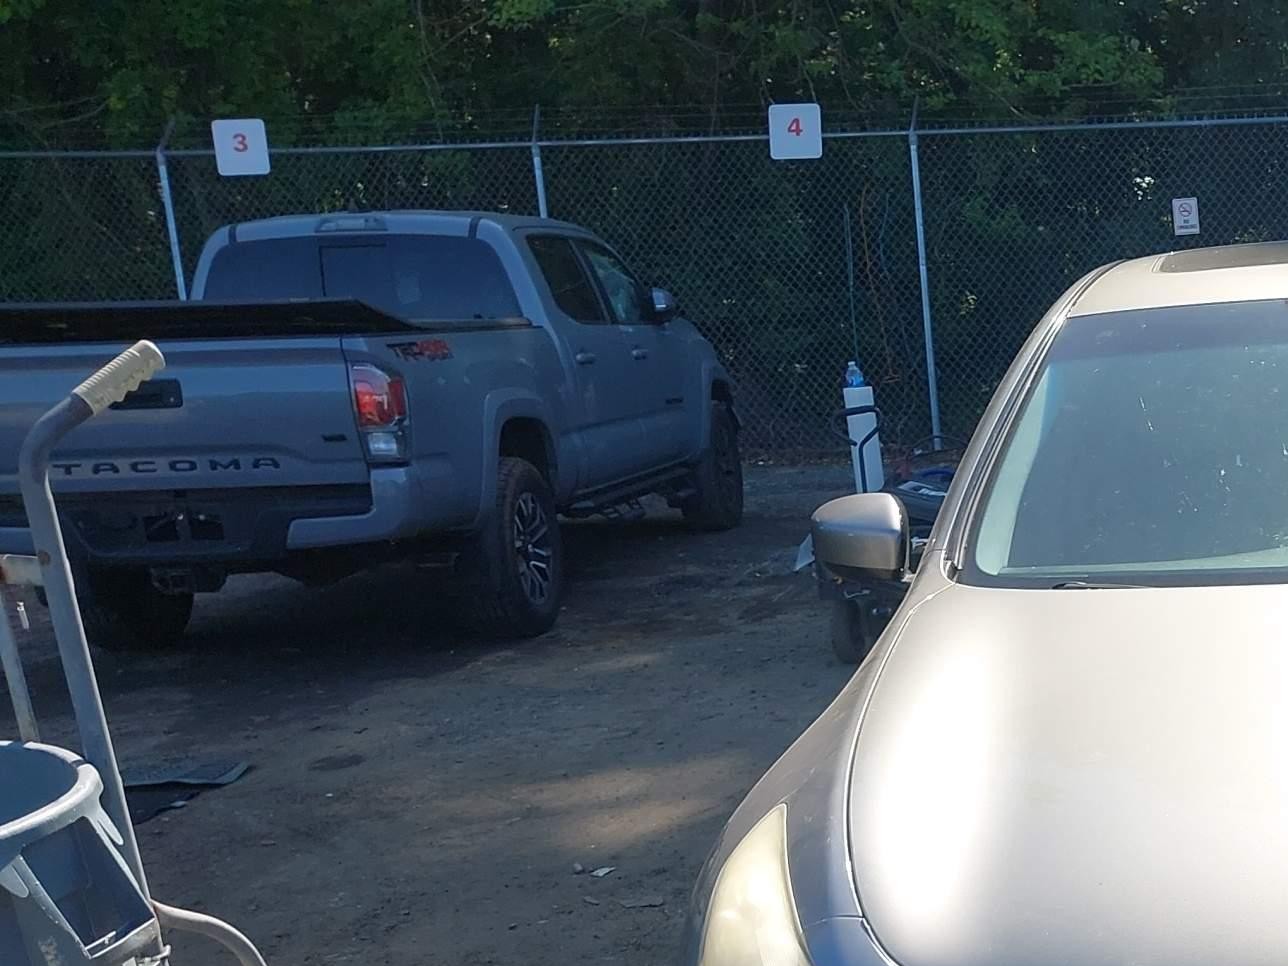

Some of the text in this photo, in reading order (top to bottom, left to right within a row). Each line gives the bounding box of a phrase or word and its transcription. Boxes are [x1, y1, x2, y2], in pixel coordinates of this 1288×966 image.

[787, 118, 803, 136] 4
[232, 133, 248, 152] 3
[52, 456, 282, 476] TACOMA
